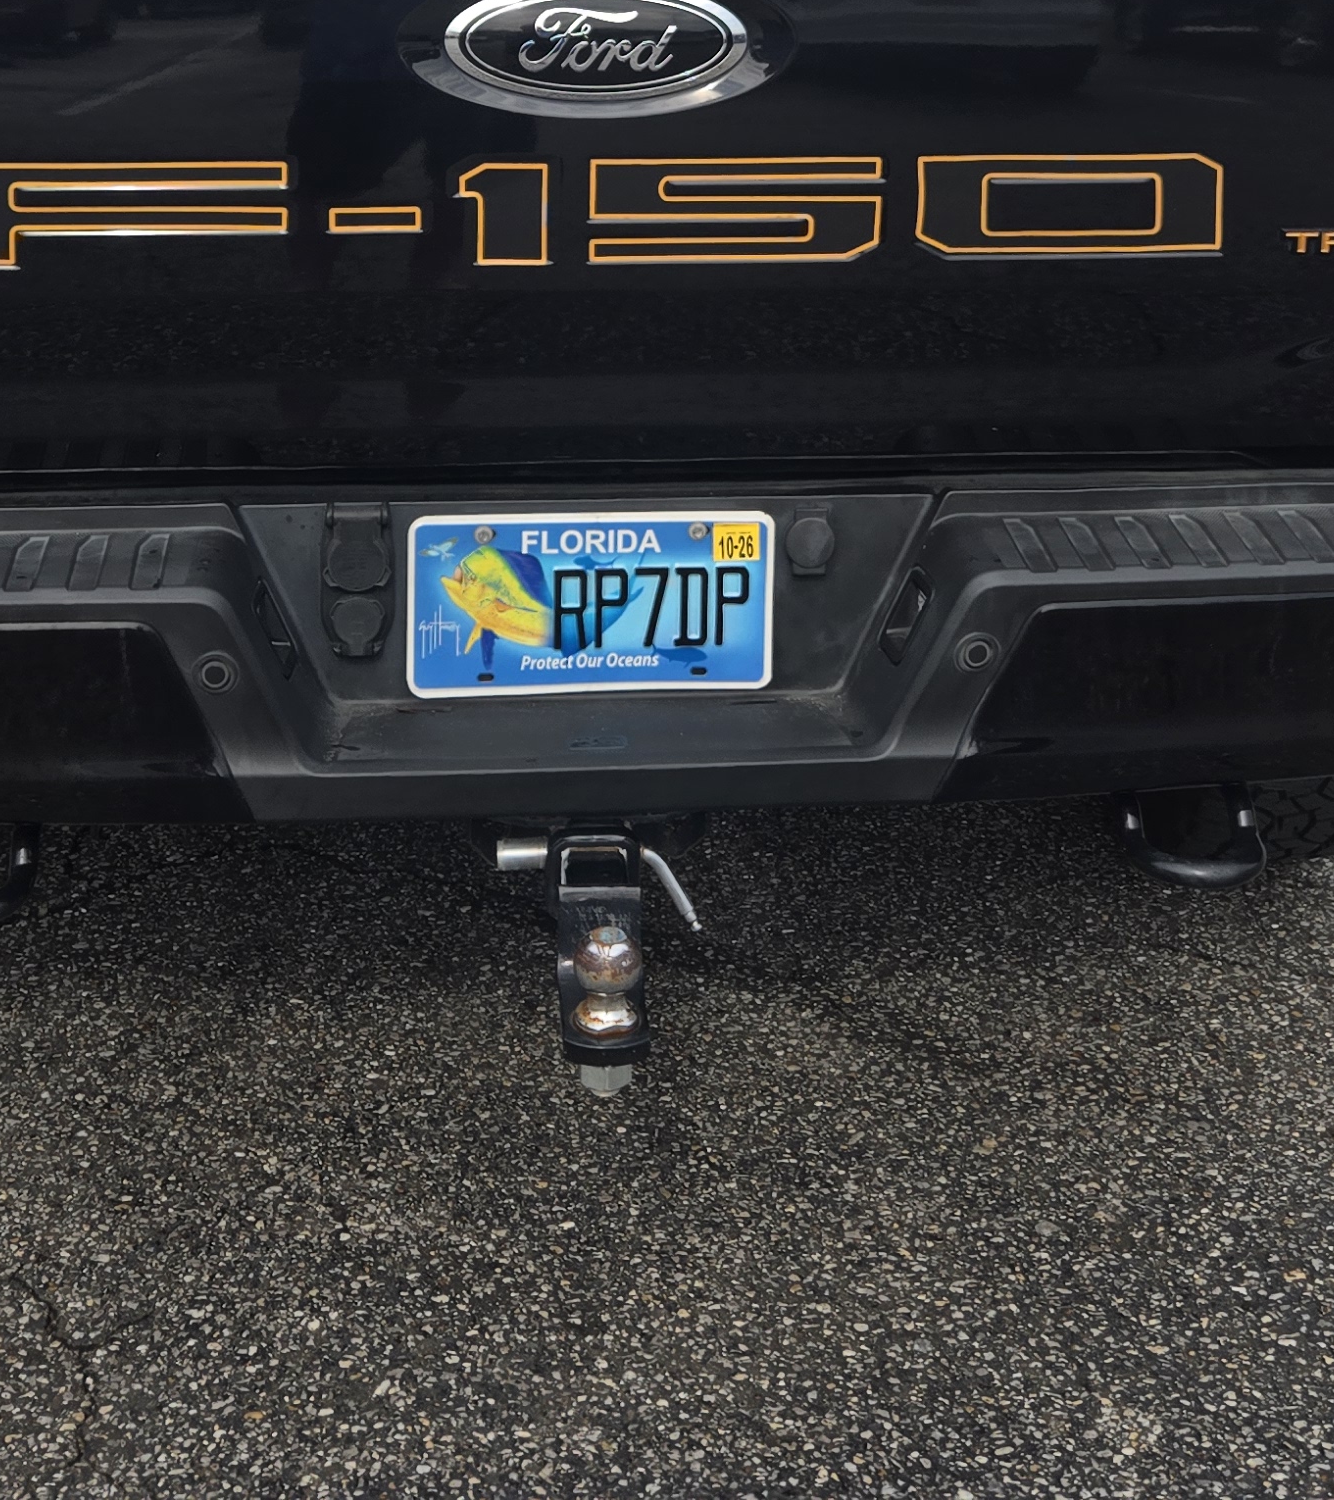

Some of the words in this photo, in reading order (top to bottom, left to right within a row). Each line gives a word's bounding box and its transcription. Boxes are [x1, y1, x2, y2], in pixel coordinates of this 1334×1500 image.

[518, 7, 678, 73] Ford
[521, 529, 662, 555] FLORIDA
[718, 534, 755, 560] 10-26
[553, 565, 750, 650] RP7DP
[520, 653, 573, 671] Protect
[577, 653, 604, 669] Our
[608, 652, 660, 668] Oceans
